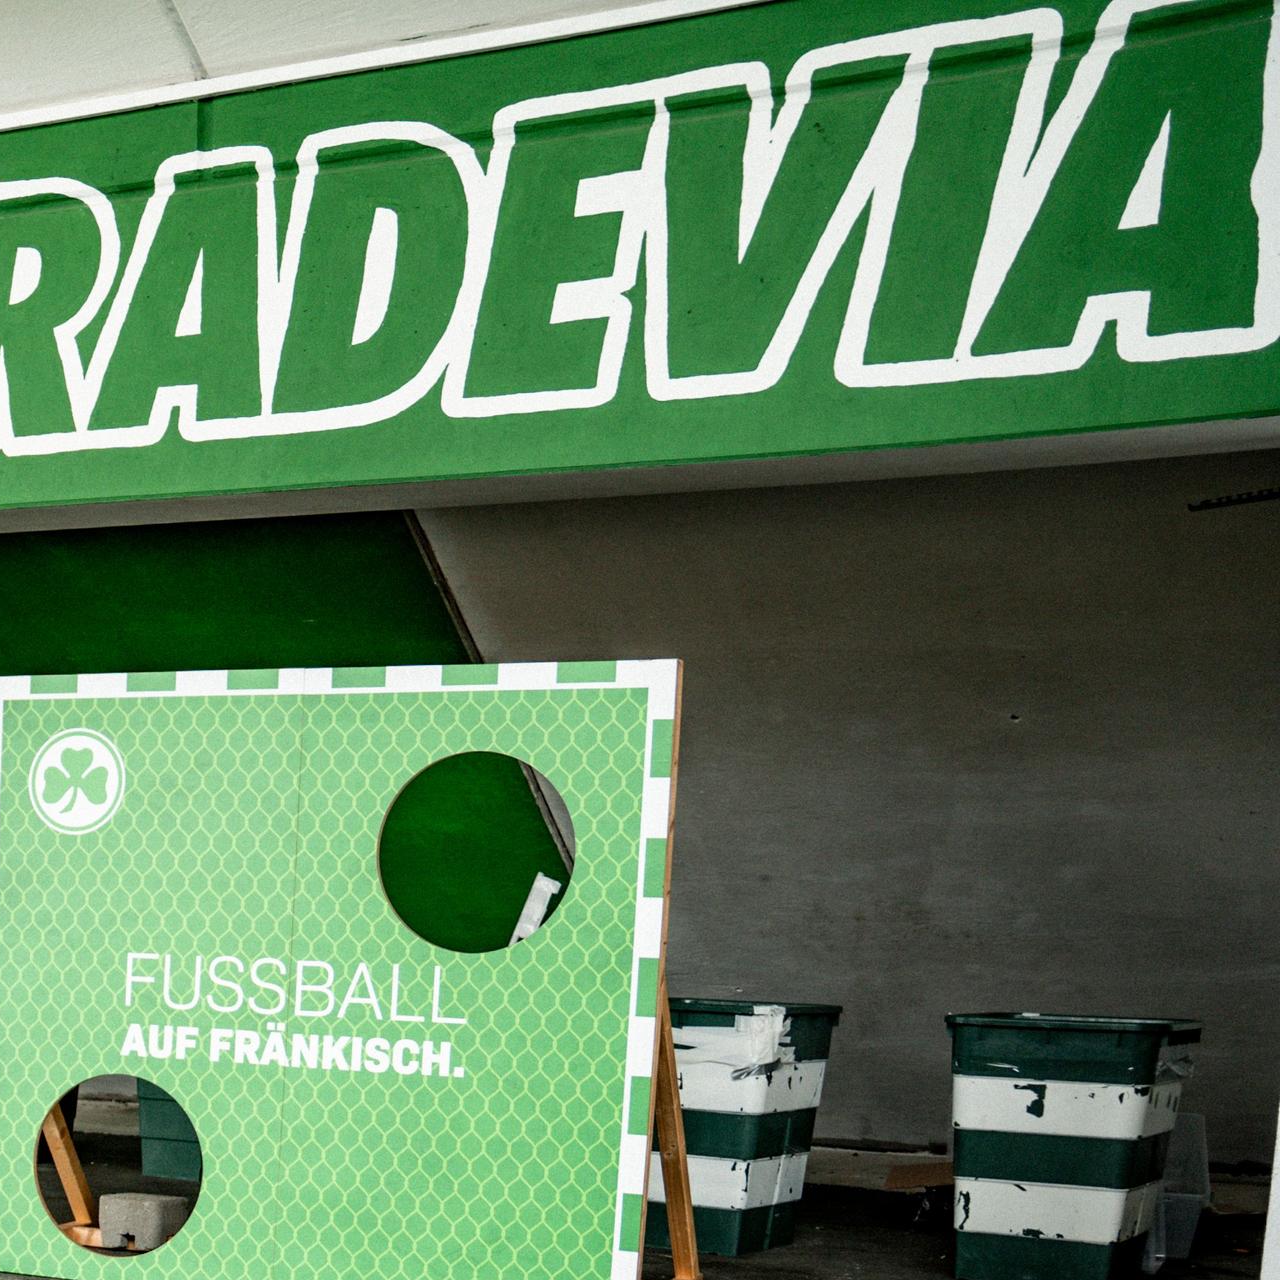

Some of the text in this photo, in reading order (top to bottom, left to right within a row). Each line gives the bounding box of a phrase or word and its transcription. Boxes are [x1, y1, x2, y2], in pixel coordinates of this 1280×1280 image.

[124, 951, 467, 1024] FUSSBALL
[119, 1021, 465, 1079] AUF FRÄNKISCH.
